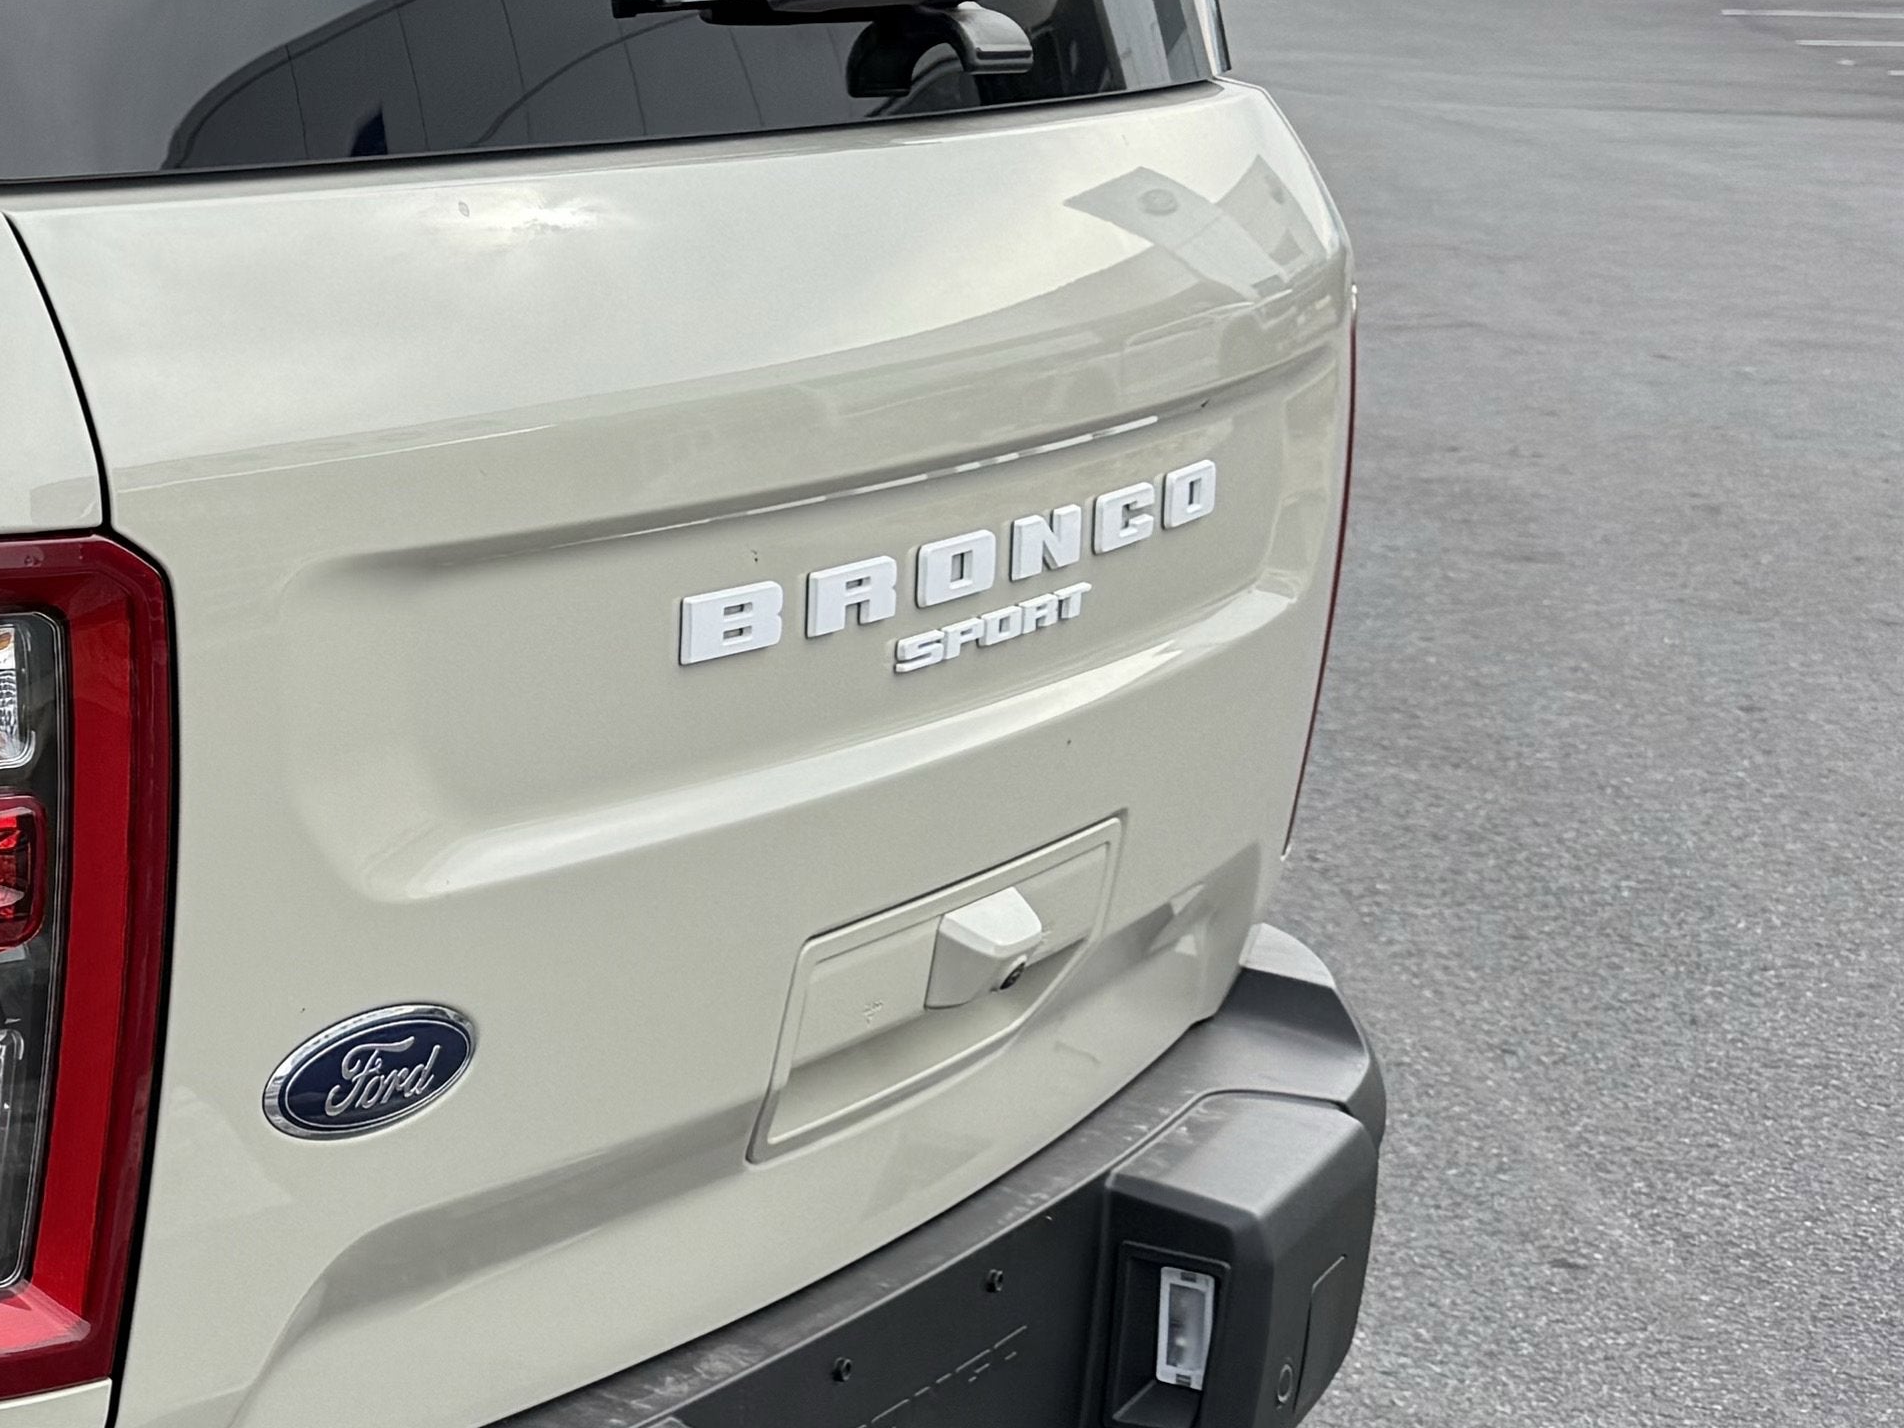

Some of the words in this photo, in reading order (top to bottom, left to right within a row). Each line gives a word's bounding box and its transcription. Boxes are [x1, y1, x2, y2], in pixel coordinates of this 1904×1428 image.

[678, 459, 1216, 666] BRONCO
[894, 581, 1092, 673] SPORT
[325, 1035, 441, 1117] Ford
